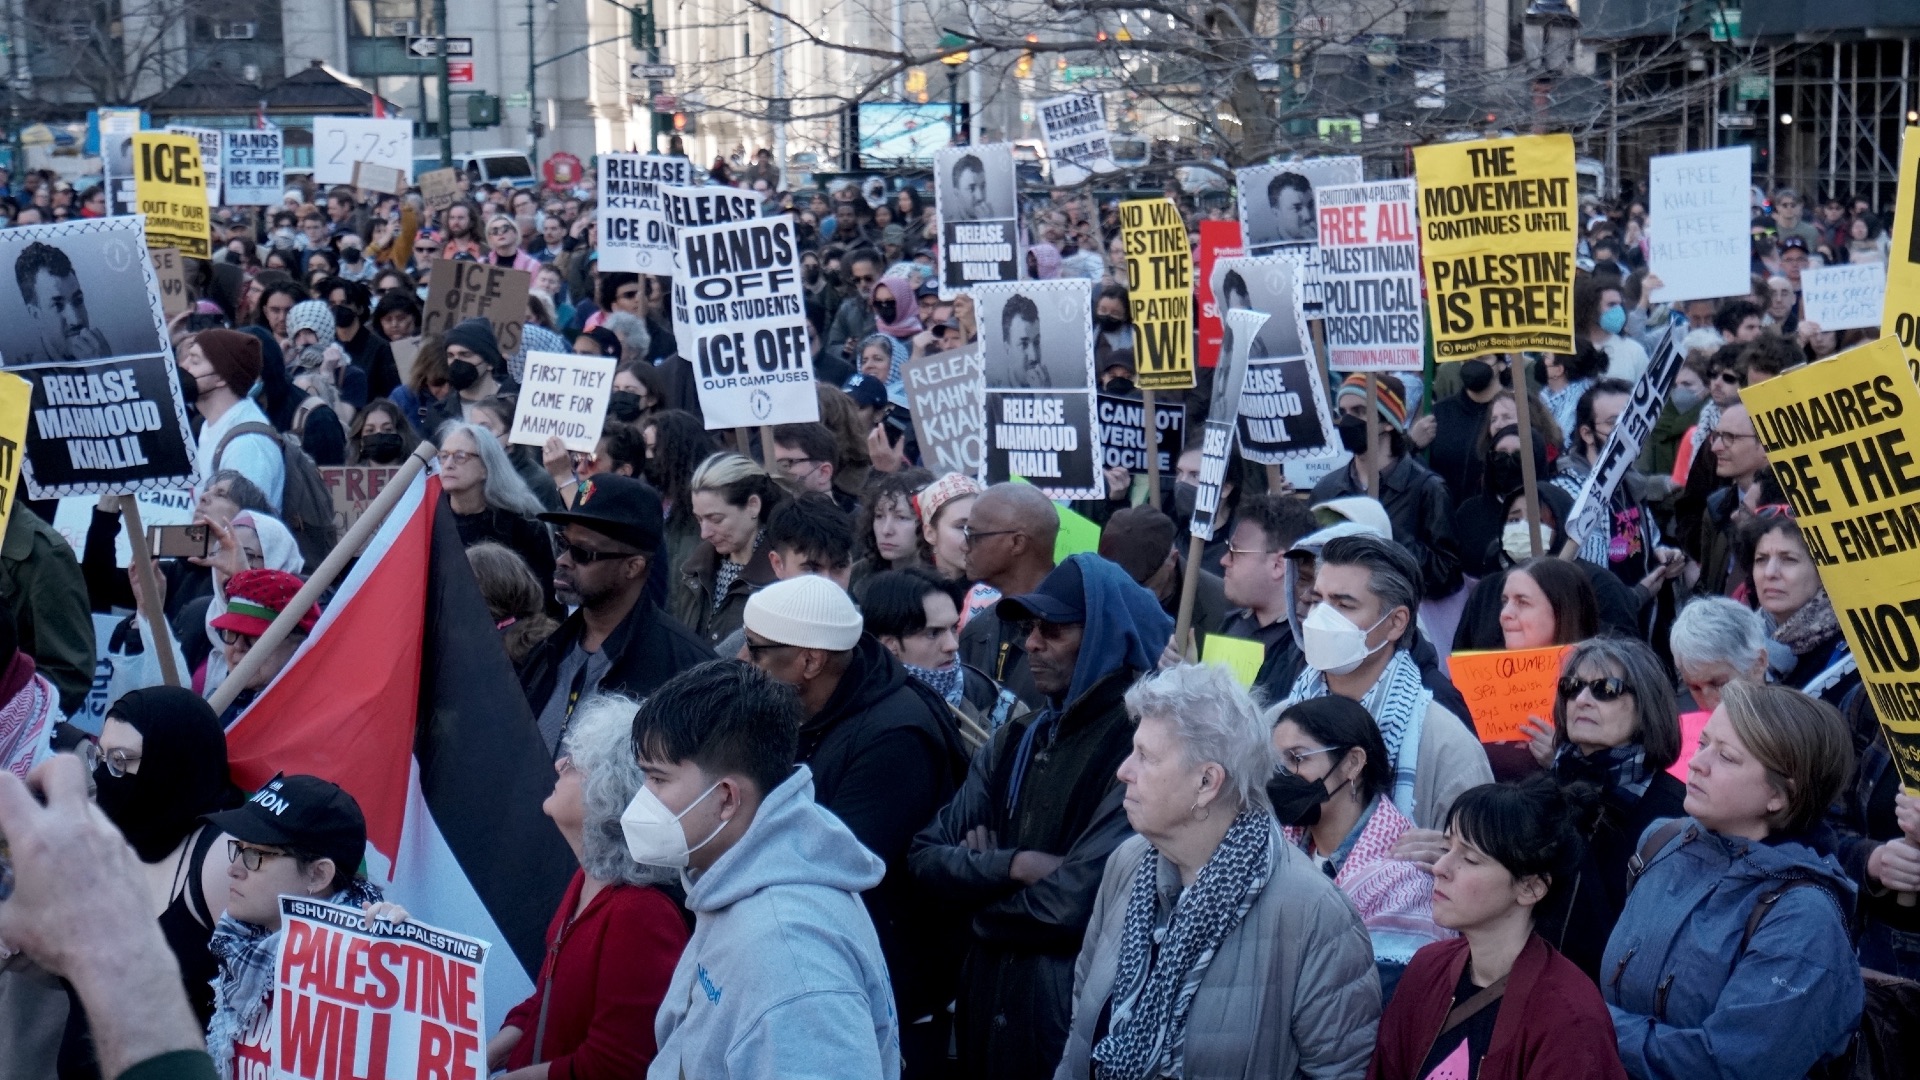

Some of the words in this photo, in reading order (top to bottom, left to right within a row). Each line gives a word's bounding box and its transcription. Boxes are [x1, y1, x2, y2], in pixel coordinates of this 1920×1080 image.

[1043, 95, 1096, 122] RELEASE
[229, 133, 279, 149] HANDS
[231, 149, 279, 157] OFF
[140, 143, 200, 187] ICE:
[606, 159, 685, 183] RELEASE
[1466, 146, 1517, 178] THE
[1677, 165, 1721, 186] FREE
[230, 171, 252, 185] ICE
[256, 171, 279, 185] OFF
[606, 179, 660, 199] MAHM
[606, 197, 661, 212] KHAL
[663, 191, 756, 227] RELEASE
[1319, 183, 1411, 206] #SHUTITDOWN4PALESTINE
[1424, 177, 1570, 217] MOVEMENT
[142, 200, 167, 215] OUT
[181, 204, 204, 220] OUR
[1320, 205, 1368, 246] FREE
[1376, 202, 1414, 243] ALL
[606, 217, 639, 242] ICE
[954, 223, 1004, 244] RELEASE
[1428, 214, 1520, 241] CONTINUES
[1525, 212, 1571, 232] UNTIL
[630, 242, 670, 251] CAMPU
[685, 222, 793, 278] HANDS
[949, 243, 1012, 263] MAHMOUD
[1322, 245, 1415, 275] PALESTINIAN
[1652, 237, 1739, 263] PALESTINE
[454, 263, 505, 298] ICE
[693, 268, 795, 301] OFF
[962, 262, 1002, 281] KHALIL
[1149, 253, 1190, 291] THE
[1432, 251, 1571, 291] PALESTINE
[445, 289, 492, 316] OFF
[695, 302, 728, 325] OUR
[731, 294, 800, 321] STUDENTS
[1325, 277, 1419, 314] POLITICAL
[1436, 291, 1474, 334] IS
[1480, 284, 1569, 329] FREE!
[423, 311, 523, 350] CAUS
[1328, 313, 1420, 345] PRISONERS
[697, 332, 750, 379] ICE
[753, 325, 806, 373] OFF
[1455, 342, 1477, 353] Party
[1477, 339, 1489, 347] for
[1490, 336, 1529, 347] Socialism
[1530, 336, 1544, 345] and
[1545, 337, 1571, 348] Liberation
[530, 363, 567, 385] FIRST
[572, 368, 606, 389] THEY
[703, 378, 738, 390] OUR
[739, 371, 810, 388] CAMPUSES
[909, 352, 981, 389] RELEAS
[42, 368, 141, 406] RELEASE
[915, 379, 981, 417] MAHM
[531, 391, 565, 410] CAME
[569, 395, 594, 414] FOR
[1002, 399, 1065, 425] RELEASE
[1100, 402, 1183, 430] CANOT
[34, 400, 162, 440] MAHMOUD
[921, 405, 981, 446] KHAL
[66, 434, 149, 470] KHALIL
[995, 425, 1078, 451] MAHMOUD
[1008, 451, 1062, 478] KHALIL
[1819, 428, 1920, 507] THE
[279, 920, 478, 1032] PALESTINE
[280, 988, 392, 1080] WILL
